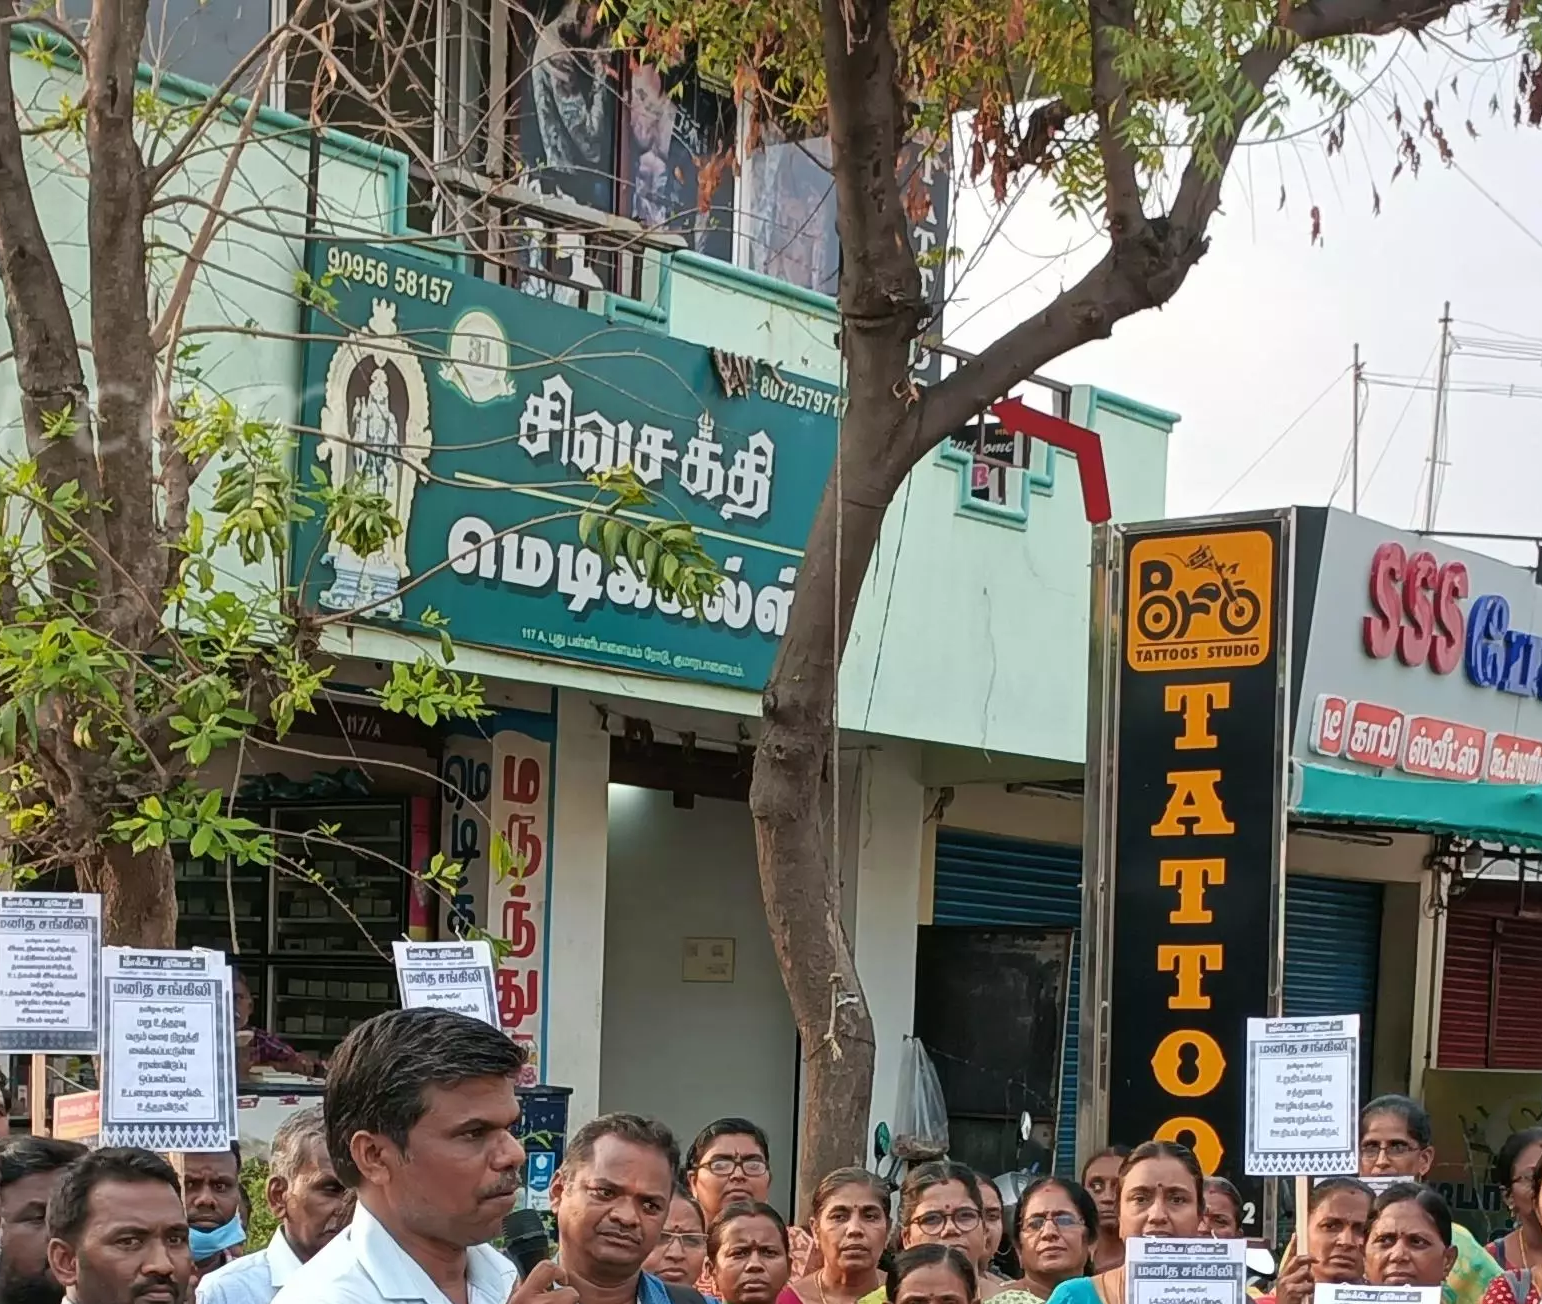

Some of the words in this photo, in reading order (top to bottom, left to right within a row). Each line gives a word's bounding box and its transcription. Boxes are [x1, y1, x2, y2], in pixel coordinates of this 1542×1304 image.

[327, 247, 390, 288] 90956
[395, 255, 453, 306] 58157
[518, 375, 775, 520] சிவசக்தி
[1362, 542, 1469, 675] SSS
[1135, 646, 1199, 665] TATTOOS
[1207, 643, 1260, 661] STUDIO
[1351, 716, 1404, 760] காபி
[39, 917, 88, 930] சங்கிலி
[406, 972, 436, 986] மனித
[439, 969, 481, 983] சங்கிலி
[113, 982, 153, 998] மனித
[157, 981, 211, 996] சங்கிலி
[1259, 1042, 1298, 1056] மனித
[1301, 1040, 1348, 1053] சங்கிலி
[1138, 1265, 1178, 1280] மனித
[1182, 1263, 1233, 1277] சங்கிலி
